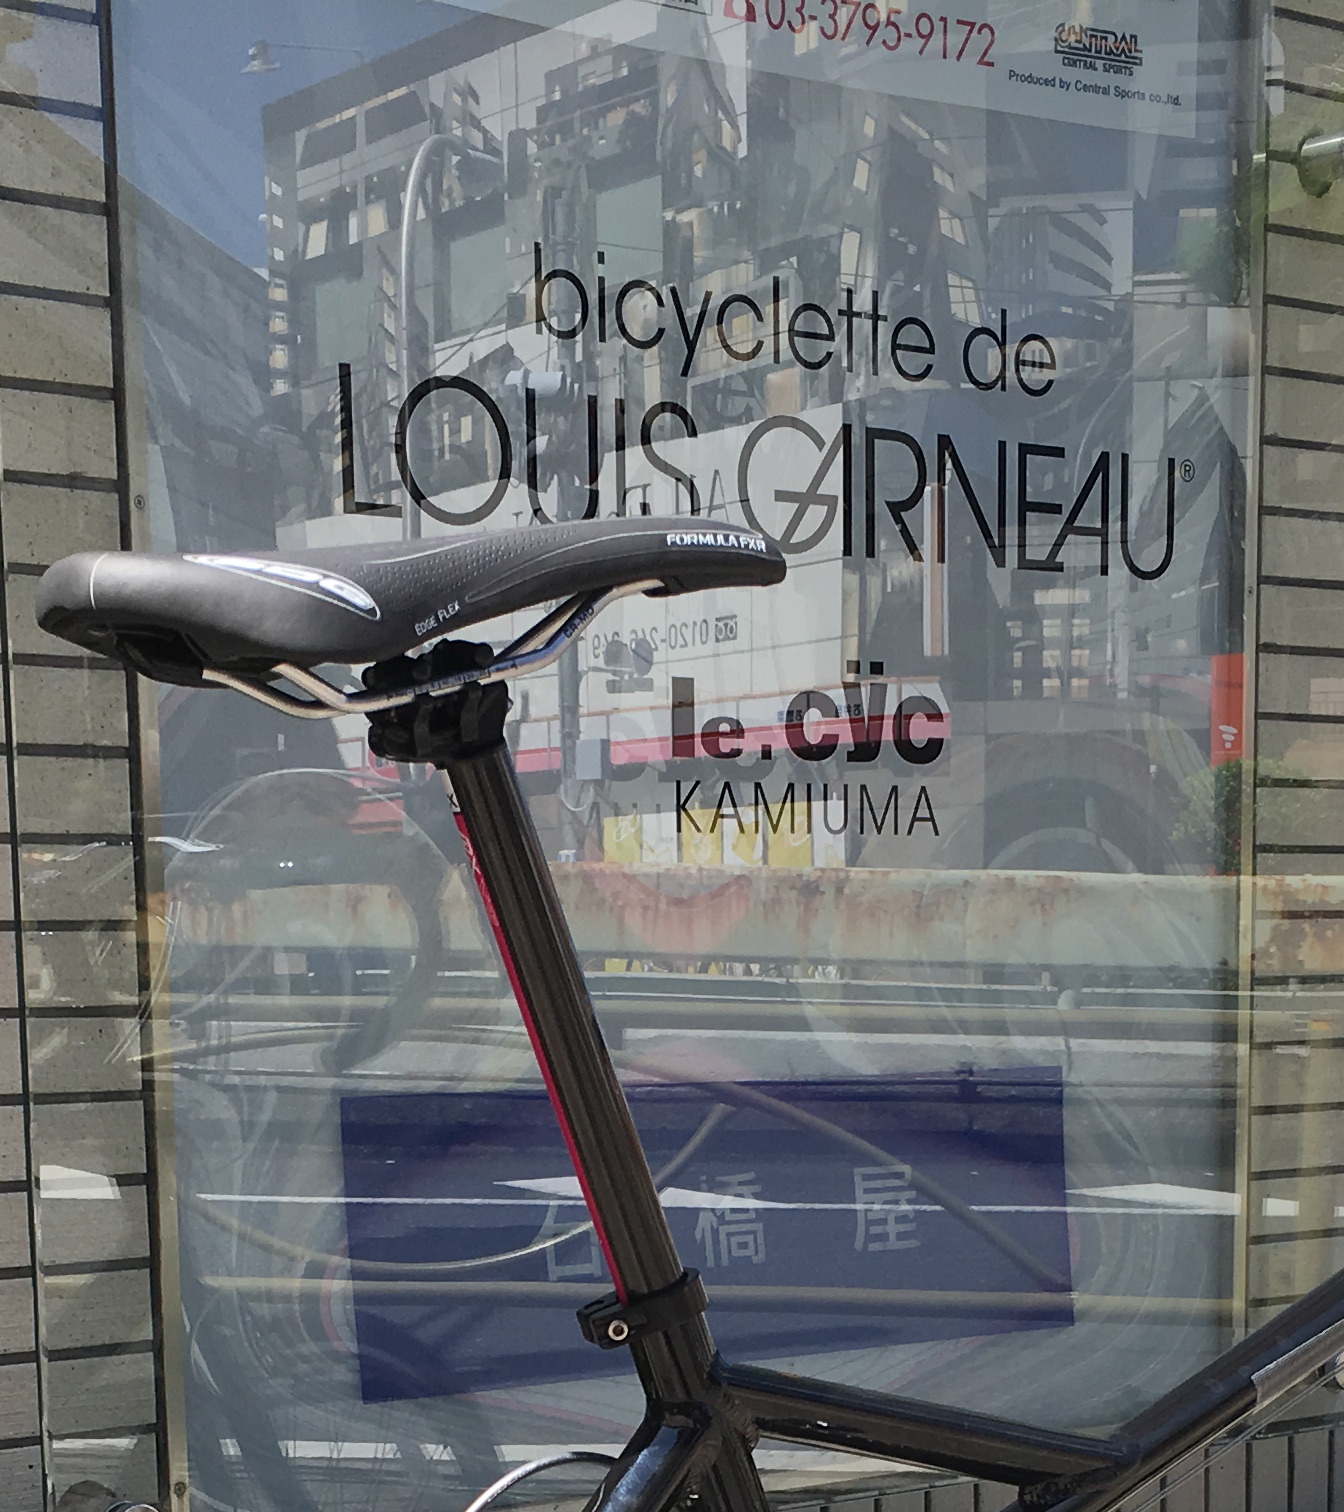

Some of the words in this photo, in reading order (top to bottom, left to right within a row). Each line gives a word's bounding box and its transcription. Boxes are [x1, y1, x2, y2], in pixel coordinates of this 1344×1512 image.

[1008, 69, 1056, 88] Produced
[1059, 78, 1071, 91] by
[1075, 80, 1111, 96] Central
[1114, 86, 1146, 100] Sports
[1062, 56, 1098, 71] CENTRAL
[1103, 62, 1134, 76] SPORTS
[533, 241, 936, 378] bicyclette
[963, 309, 1056, 397] de
[338, 362, 700, 527] LOUIS
[738, 415, 1176, 581] GARNEAU
[666, 533, 738, 548] FORMULA
[739, 537, 767, 552] FXR
[414, 615, 437, 637] EDGE
[438, 600, 461, 623] FLEX
[675, 779, 940, 837] KAMIUMA
